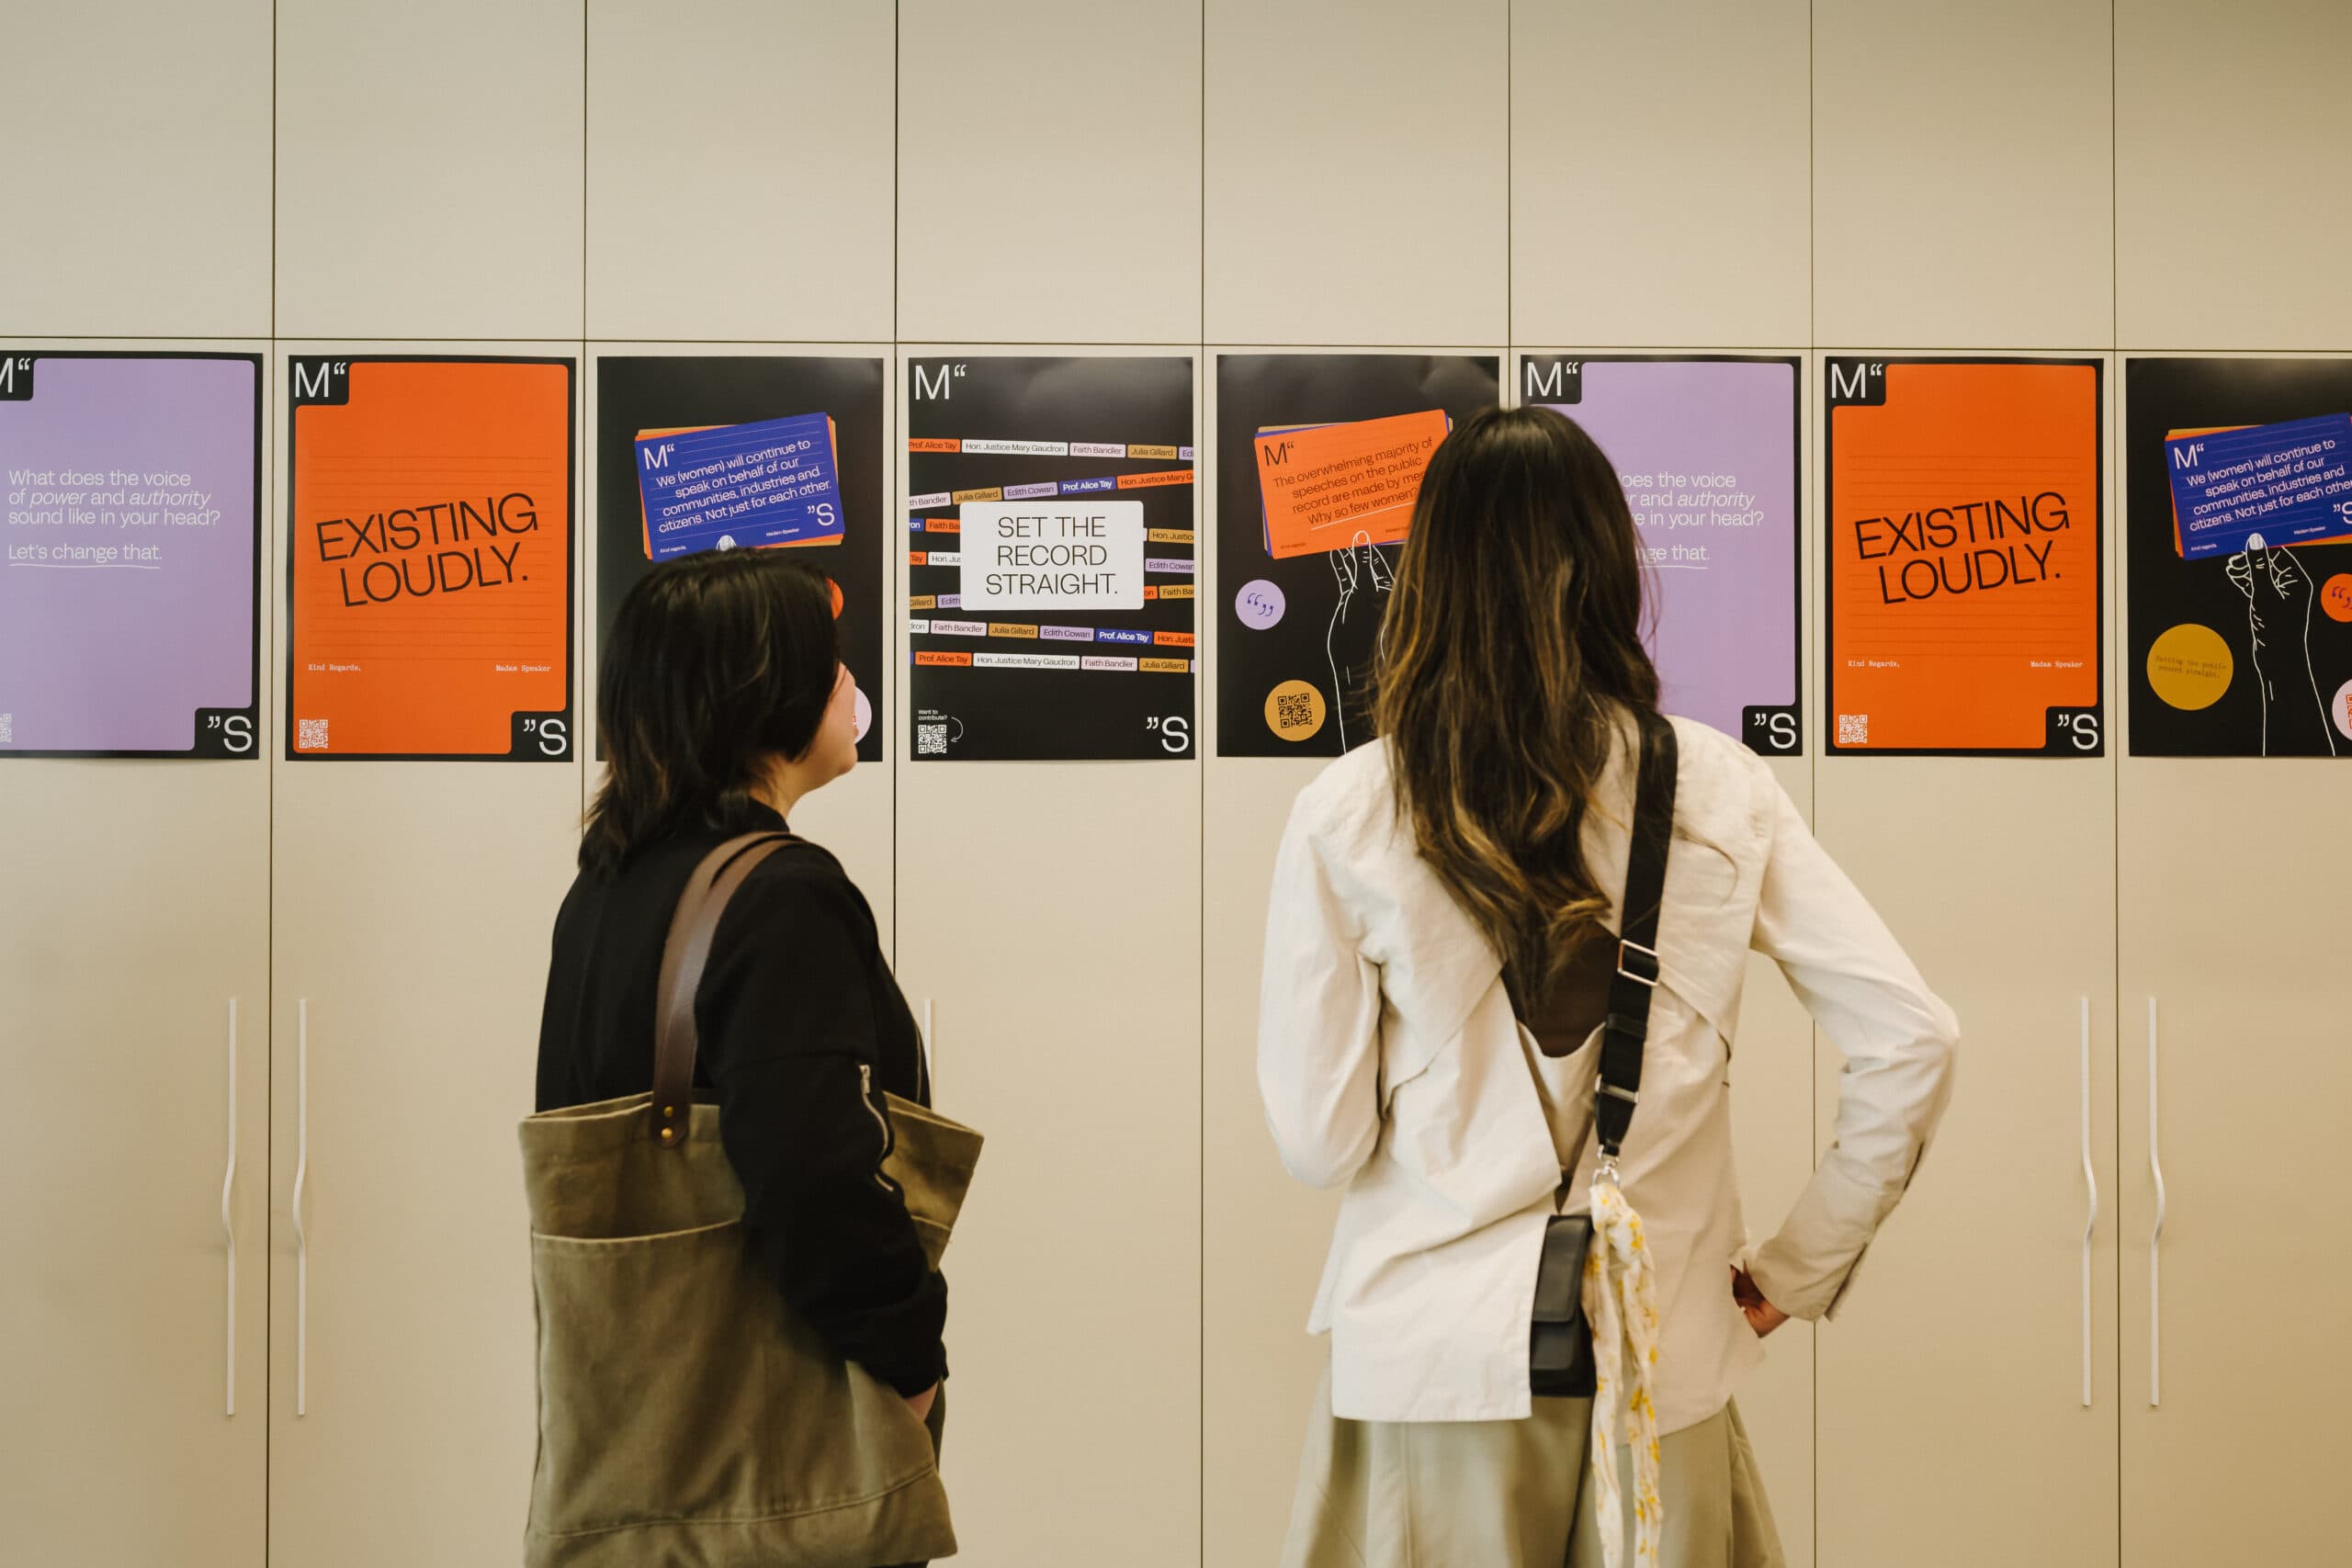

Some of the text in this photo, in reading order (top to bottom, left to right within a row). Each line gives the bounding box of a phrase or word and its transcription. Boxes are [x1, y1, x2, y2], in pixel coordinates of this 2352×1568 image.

[944, 442, 957, 450] Tay
[1012, 445, 1030, 453] Mary
[1031, 445, 1065, 453] Gaudron
[1073, 446, 1123, 455] Faith Bandler
[1131, 447, 1173, 457] Julia Gillard
[656, 439, 810, 488] We (women) will continue to
[1272, 436, 1434, 489] The overwhelming majority of
[2187, 439, 2335, 487] We (women) will continue to
[8, 469, 191, 487] What does the voice
[674, 457, 799, 500] speak on behalf of our
[1062, 479, 1113, 491] Prof. Alice Tay
[1138, 476, 1166, 484] Justice
[1167, 473, 1185, 482] Mary
[1292, 456, 1423, 500] speeches on the public
[1657, 470, 1687, 488] the
[1690, 471, 1736, 488] voice
[2205, 457, 2325, 499] speak on behalf of our
[662, 466, 820, 517] communities, industries and
[956, 491, 999, 502] Julia Gillard
[1007, 486, 1054, 497] Edith Cowan
[1292, 495, 1330, 514] record
[1332, 491, 1351, 502] are
[1351, 481, 1385, 499] made
[1385, 478, 1400, 491] by
[2193, 465, 2346, 515] communities, industries and
[8, 489, 211, 510] of power and authority
[659, 479, 832, 534] citizens. Not just for each other.
[919, 496, 946, 505] Bandler
[1307, 487, 1419, 525] Why so few women?
[1640, 490, 1673, 507] and
[1677, 490, 1756, 510] authority
[8, 509, 220, 528] sound like in your head?
[2189, 513, 2233, 532] citizens.
[2234, 505, 2256, 520] Not
[2257, 501, 2279, 515] just
[2278, 495, 2296, 508] for
[2296, 487, 2324, 502] each
[316, 492, 538, 562] EXISTING
[998, 516, 1106, 538] SET THE
[1650, 509, 1664, 526] in
[1668, 513, 1706, 529] your
[1711, 510, 1764, 526] head?
[1855, 491, 2070, 560] EXISTING
[52, 543, 118, 563] change
[123, 544, 163, 560] that.
[998, 545, 1107, 566] RECORD
[1671, 544, 1710, 561] that.
[340, 542, 528, 607] LOUDLY.
[1879, 539, 2061, 604] LOUDLY.
[986, 573, 1118, 595] STRAIGHT.
[934, 624, 953, 632] Faith
[954, 625, 983, 633] Bandler
[992, 626, 1035, 636] Julia Gillard
[1044, 628, 1091, 638] Edith Cowan
[1099, 631, 1149, 643] Prof. Alice Tay
[308, 663, 361, 672] Kind Regards,
[495, 663, 551, 673] Madam Speaker
[919, 654, 934, 662] Prof.
[955, 655, 968, 664] Tay
[994, 657, 1076, 667] Justice Mary Gaudron
[1104, 660, 1134, 669] Bandler
[1142, 660, 1185, 670] Julia Gillard
[1848, 660, 1900, 669] Kind Regards,
[2030, 660, 2084, 670] Madam Speaker
